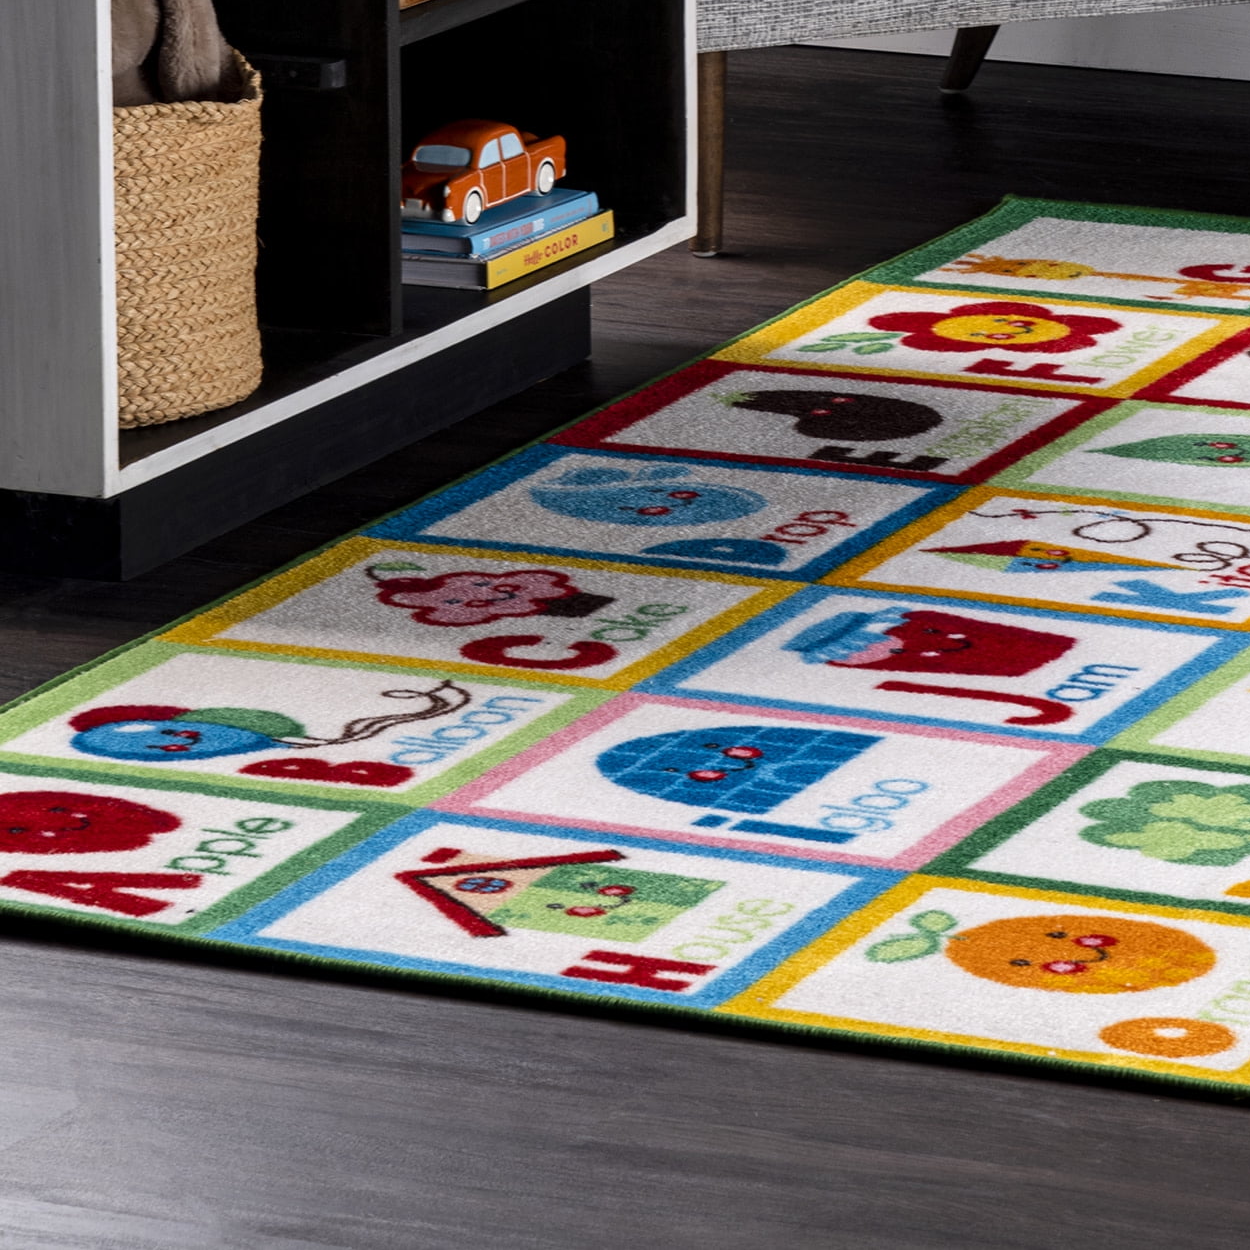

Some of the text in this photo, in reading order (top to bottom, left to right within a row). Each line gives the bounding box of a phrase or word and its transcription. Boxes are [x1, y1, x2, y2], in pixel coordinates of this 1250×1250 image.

[544, 234, 578, 258] COLOR
[640, 509, 859, 567] Drop
[459, 603, 689, 670] Cake
[873, 662, 1141, 726] Jam
[238, 695, 545, 787] Balloon
[0, 816, 295, 917] Apple
[560, 898, 796, 992] House
